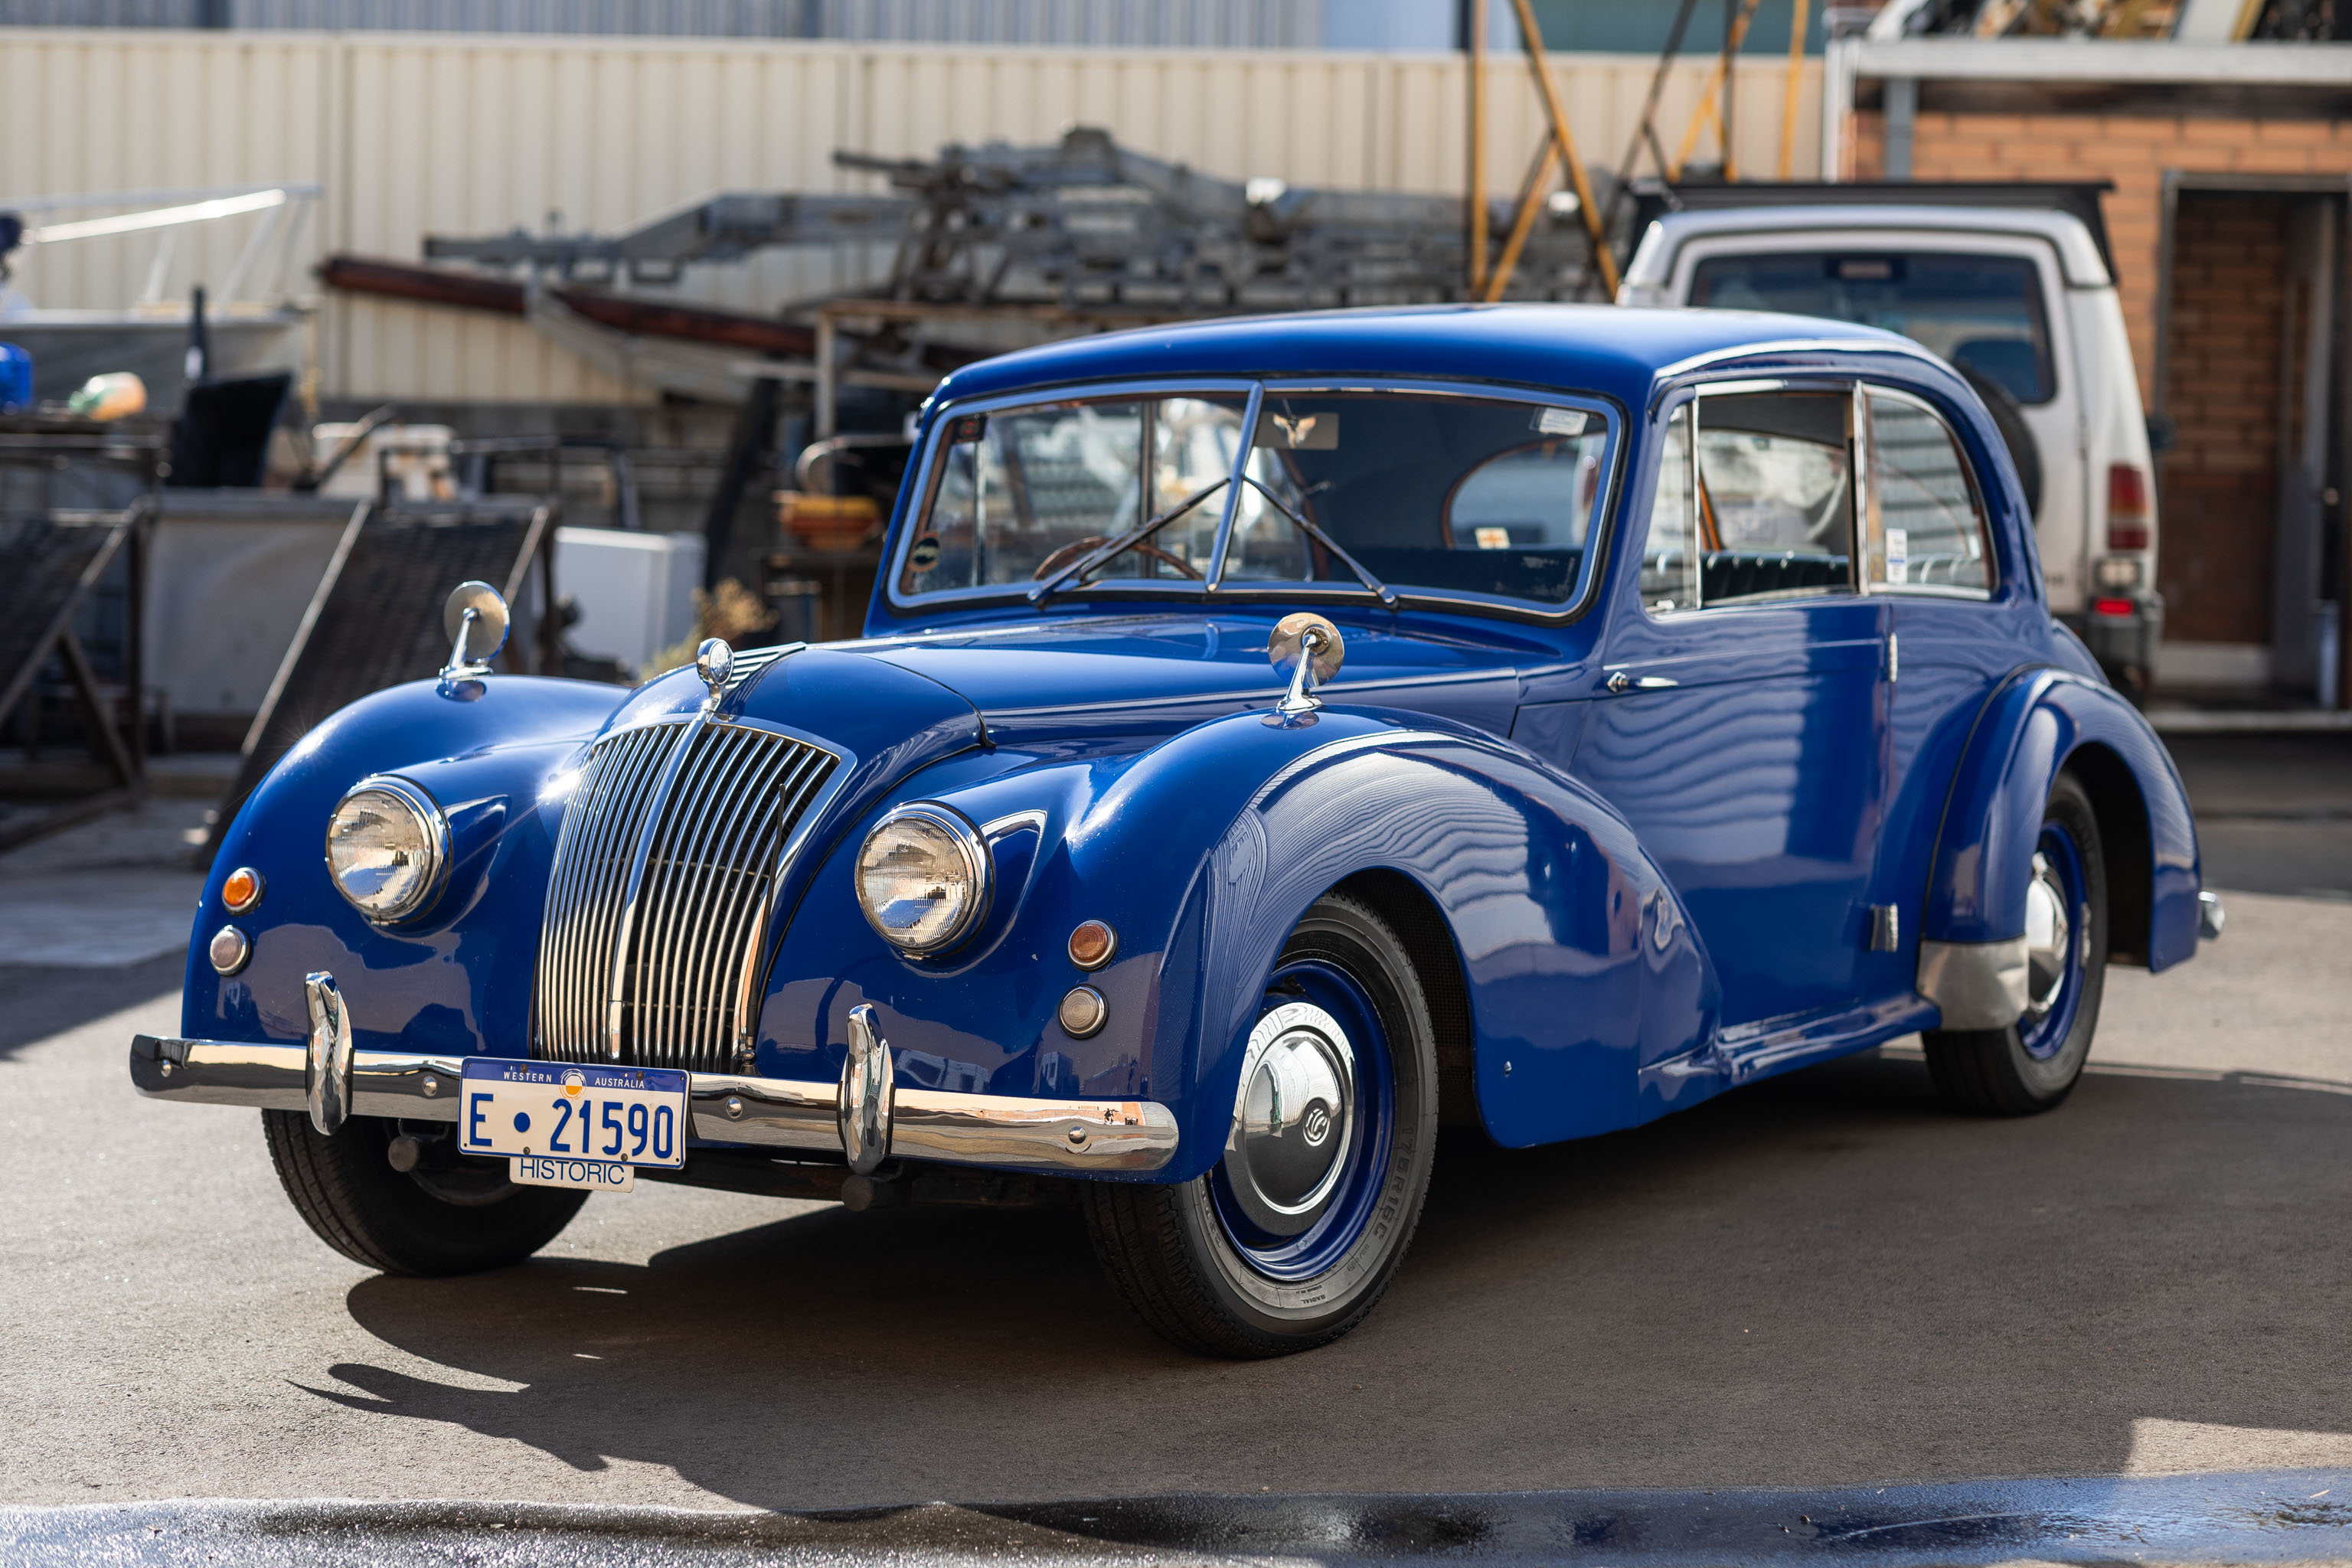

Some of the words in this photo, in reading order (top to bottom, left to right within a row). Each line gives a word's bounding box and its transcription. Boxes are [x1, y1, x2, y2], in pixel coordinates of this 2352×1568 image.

[503, 1071, 552, 1083] WESTERN
[594, 1077, 645, 1089] AUSTRALIA
[469, 1093, 494, 1147] E
[550, 1098, 674, 1159] 21590
[520, 1159, 625, 1185] HISTORIC
[1299, 1294, 1326, 1305] RADIAL
